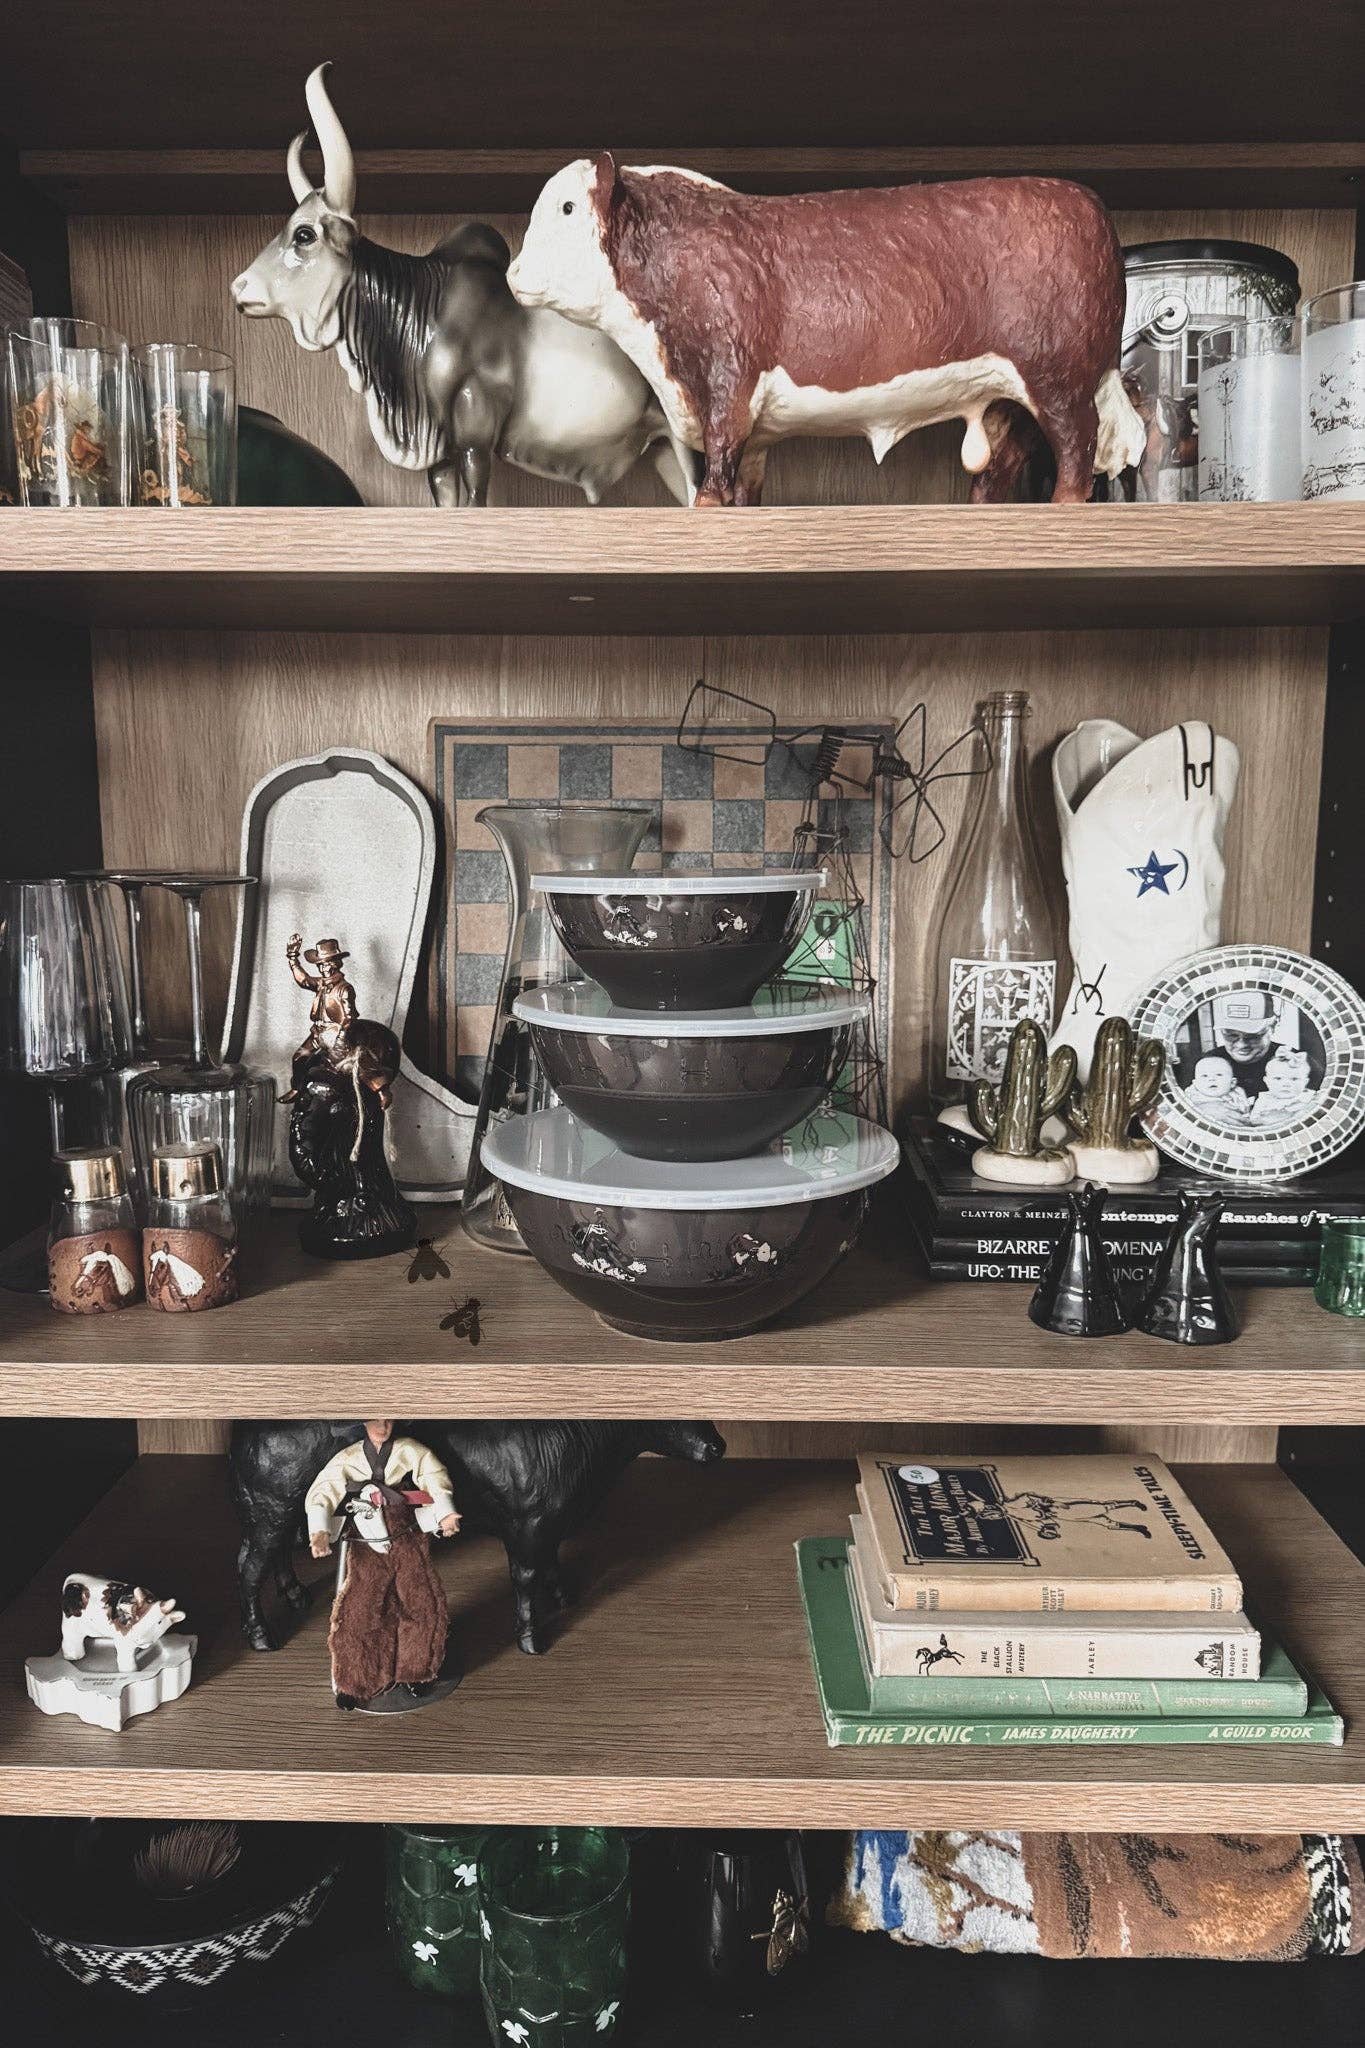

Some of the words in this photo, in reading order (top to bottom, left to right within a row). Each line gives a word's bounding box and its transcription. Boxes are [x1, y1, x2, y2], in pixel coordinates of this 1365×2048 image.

[961, 1210, 1010, 1218] CLAYTON
[1025, 1211, 1070, 1219] MEINZE
[1100, 1210, 1179, 1224] ontempo
[1219, 1212, 1298, 1224] Ranches
[1300, 1210, 1317, 1227] of
[977, 1240, 1050, 1255] BIZARRE
[1102, 1241, 1164, 1255] OMENA
[968, 1264, 1004, 1278] UFO:
[1007, 1265, 1041, 1279] THE
[1133, 1466, 1163, 1493] TALES
[927, 1479, 952, 1512] MONK
[910, 1496, 927, 1515] TALE
[916, 1518, 933, 1536] THE
[940, 1513, 968, 1556] MAJOR
[1151, 1494, 1206, 1560] SLEEPY-TIME
[1079, 1691, 1141, 1702] NARRATIVE
[856, 1726, 898, 1744] THE
[901, 1726, 975, 1744] PICNIC
[1001, 1727, 1047, 1740] JAMES
[1050, 1727, 1139, 1740] DAUGHERTY
[1208, 1727, 1218, 1738] A
[1222, 1727, 1267, 1738] GUILD
[1270, 1727, 1315, 1738] BOOK
